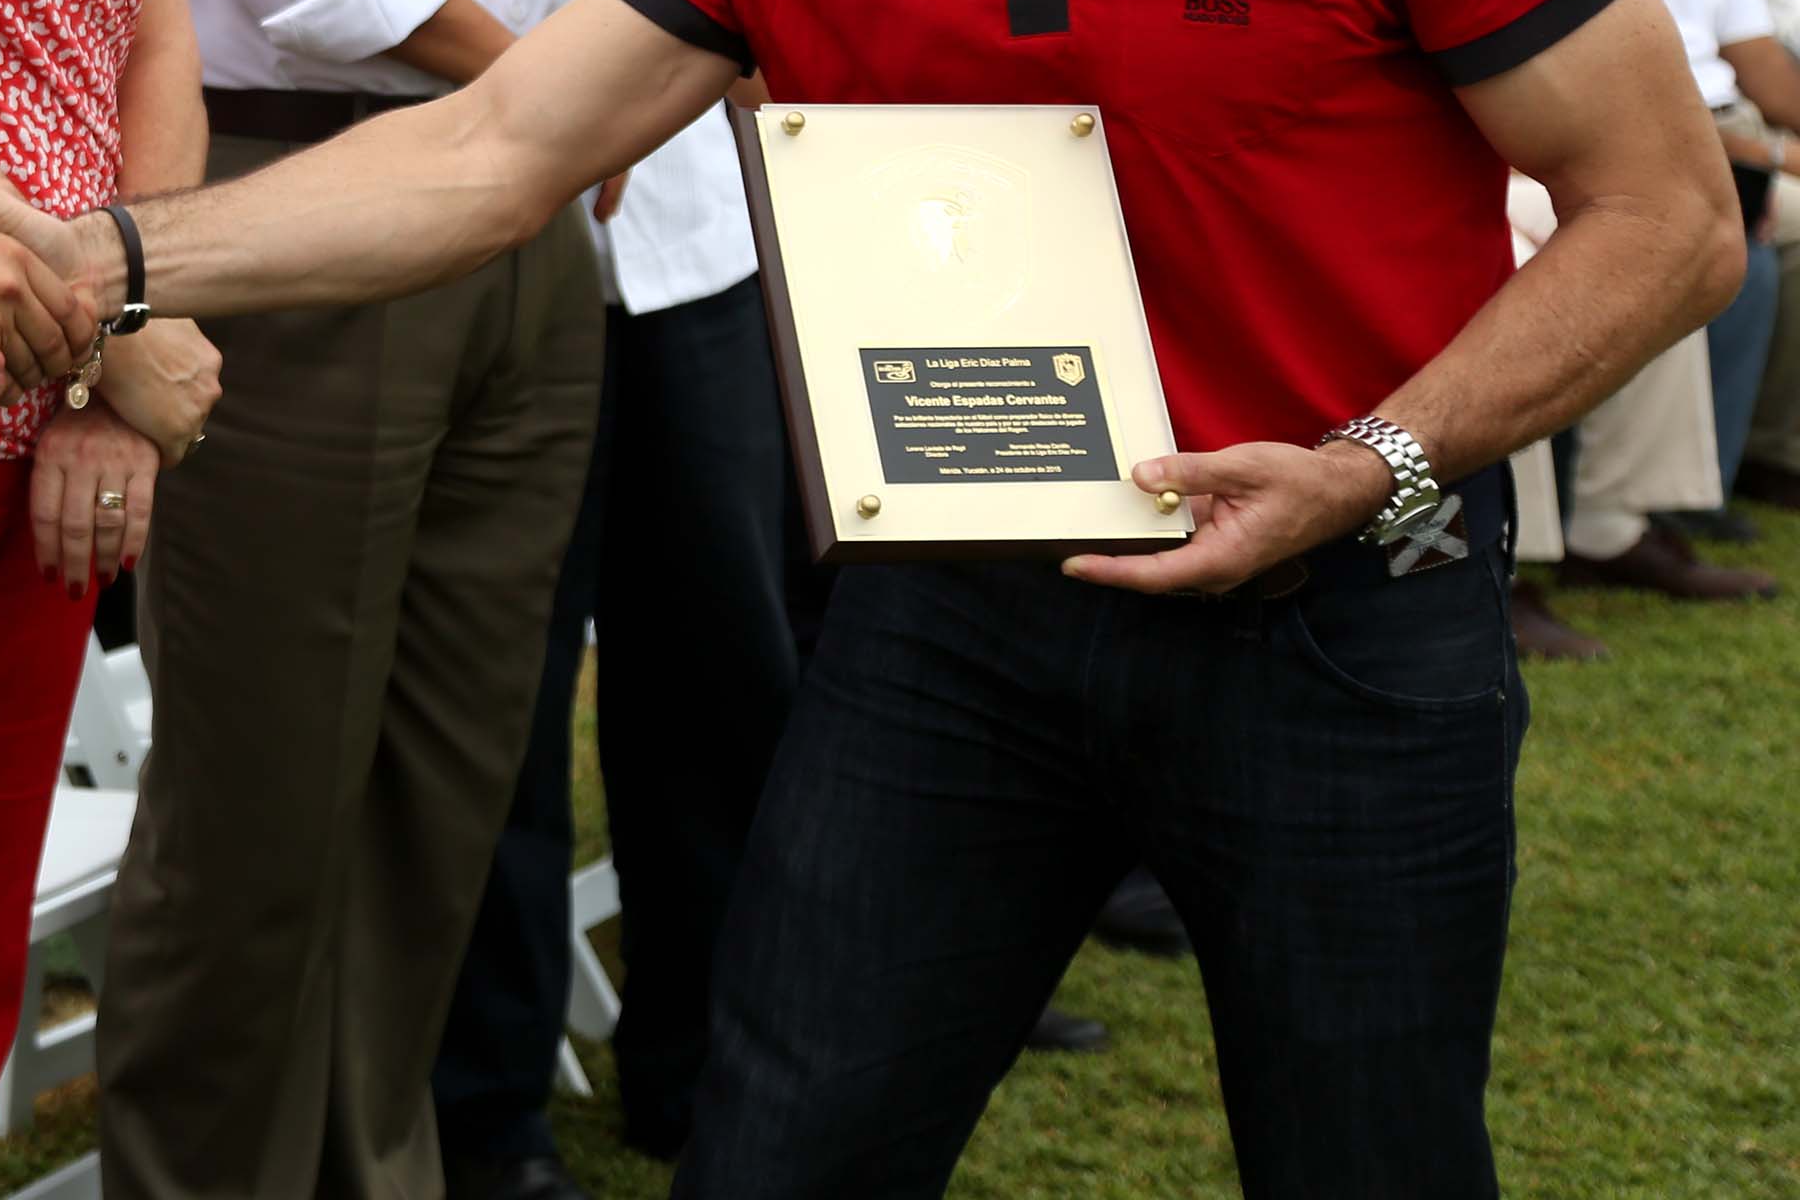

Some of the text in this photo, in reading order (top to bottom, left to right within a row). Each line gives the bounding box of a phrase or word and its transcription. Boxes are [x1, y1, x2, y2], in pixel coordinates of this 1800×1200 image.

[926, 359, 939, 368] La
[939, 359, 960, 369] Liga
[960, 359, 979, 368] Eric
[1002, 358, 1032, 367] Palma
[904, 394, 1068, 408] Vicente Espadas Cervantes
